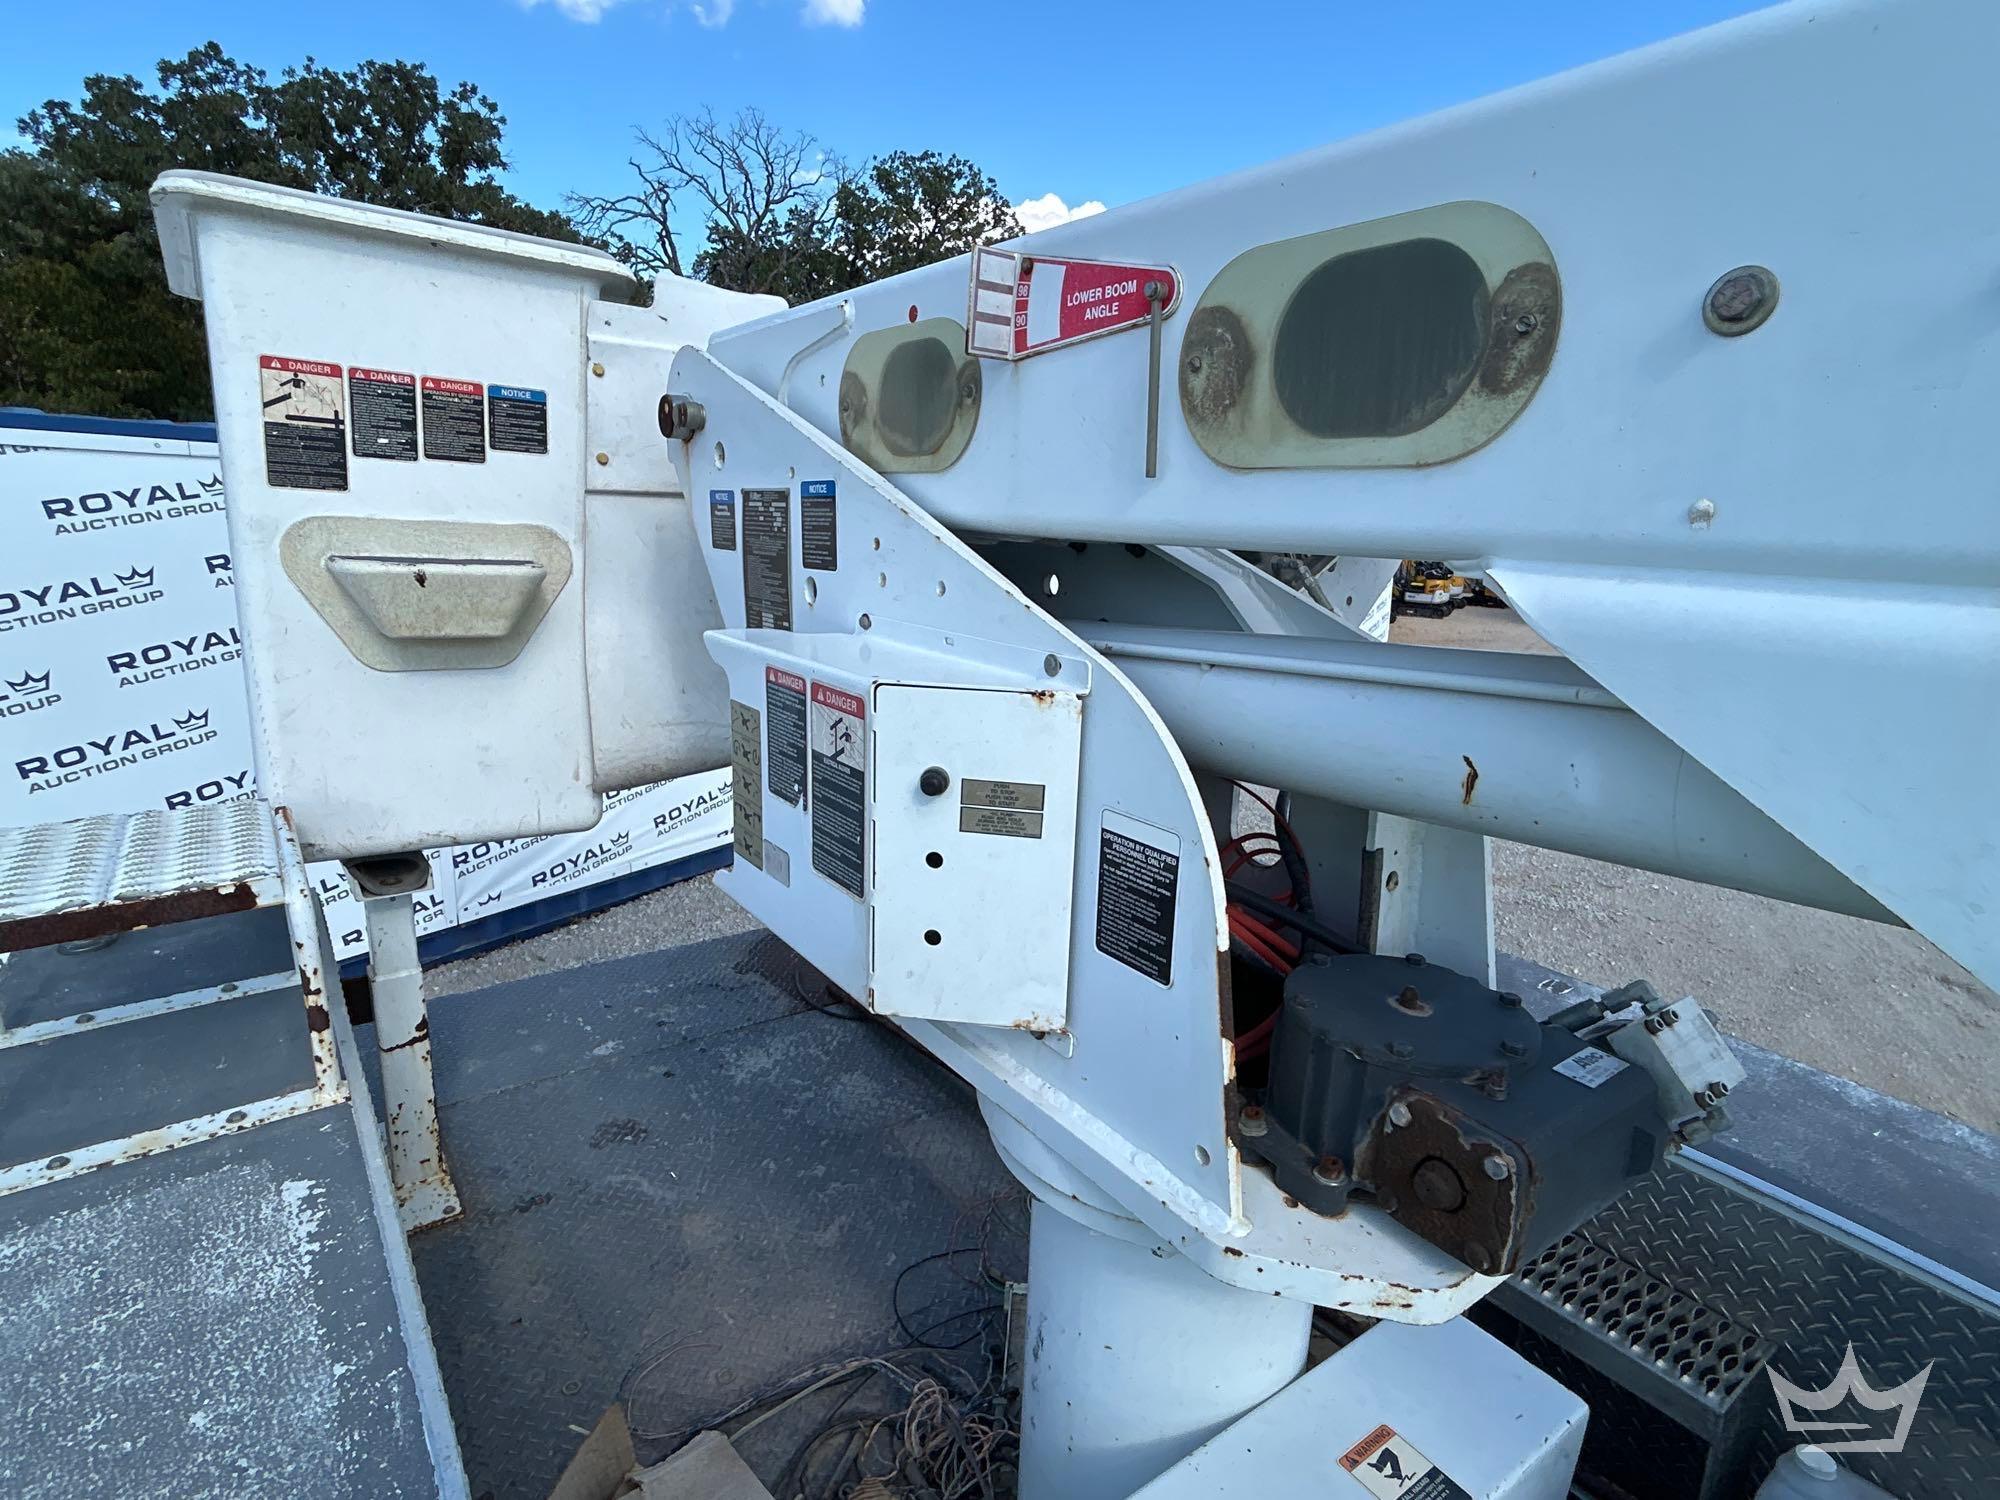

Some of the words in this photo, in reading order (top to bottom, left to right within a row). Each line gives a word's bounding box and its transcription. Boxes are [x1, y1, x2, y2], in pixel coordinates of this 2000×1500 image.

[1018, 284, 1029, 297] 98
[1067, 286, 1102, 307] LOWER
[1104, 279, 1137, 298] BOOM
[1015, 314, 1026, 327] 90
[1084, 302, 1119, 321] ANGLE
[288, 360, 331, 374] DANGER
[370, 371, 411, 384] DANGER
[440, 381, 474, 392] DANGER
[501, 388, 532, 399] NOTICE
[41, 482, 201, 519] ROYAL
[809, 484, 827, 493] NOTICE
[55, 510, 163, 535] AUCTION
[167, 502, 226, 518] GROU
[0, 577, 118, 615] OYAL
[0, 607, 76, 632] CTION
[81, 590, 164, 615] GROUP
[119, 655, 217, 688] AUCTION
[777, 673, 804, 690] DANGER
[826, 691, 857, 713] DANGER
[15, 723, 176, 780] ROYAL
[29, 754, 138, 794] AUCTION
[141, 730, 218, 760] GROUP
[164, 770, 256, 810] ROY
[602, 790, 643, 813] UCTION
[653, 790, 718, 829] ROYAL
[657, 811, 701, 837] AUCTION
[452, 838, 516, 868] ROY
[458, 846, 518, 879] AUCTION
[593, 845, 632, 868] GROUP
[1103, 832, 1135, 849] OPERATION
[1135, 844, 1144, 852] BY
[1144, 848, 1177, 866] QUALIFIED
[1112, 843, 1146, 862] PERSONNEL
[1148, 858, 1164, 868] ONLY
[532, 843, 611, 887] ROYAL
[1354, 1428, 1391, 1458] WARNING
